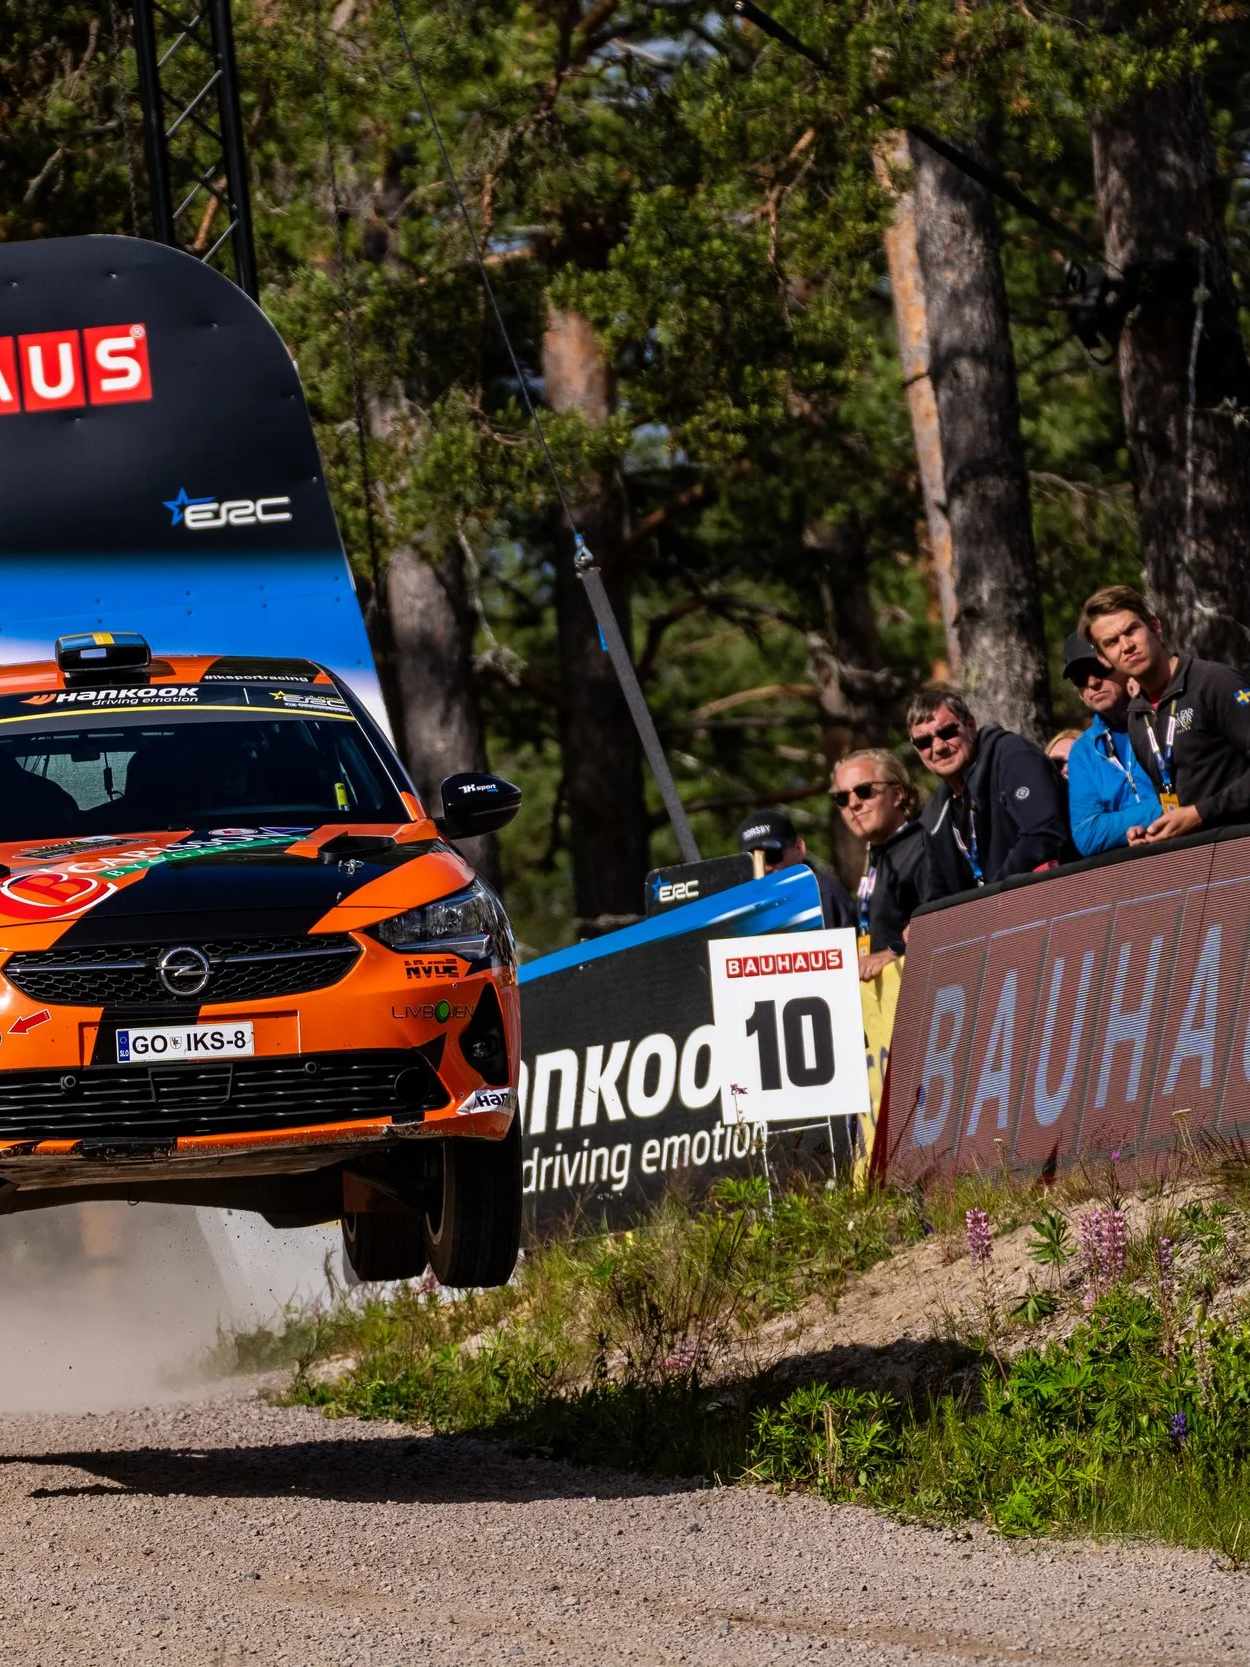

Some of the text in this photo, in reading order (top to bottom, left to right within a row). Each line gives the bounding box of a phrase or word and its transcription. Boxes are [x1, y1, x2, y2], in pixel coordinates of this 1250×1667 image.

[183, 495, 293, 529] ERC
[91, 698, 140, 706] driving
[659, 880, 699, 902] ERC
[728, 950, 842, 976] BAUHAUS
[132, 1035, 168, 1054] GO
[186, 1030, 246, 1052] IKS-8
[745, 995, 836, 1092] 10
[911, 924, 1250, 1149] BAUHA
[520, 1023, 722, 1135] nkoo
[522, 1119, 769, 1194] driving emotion
